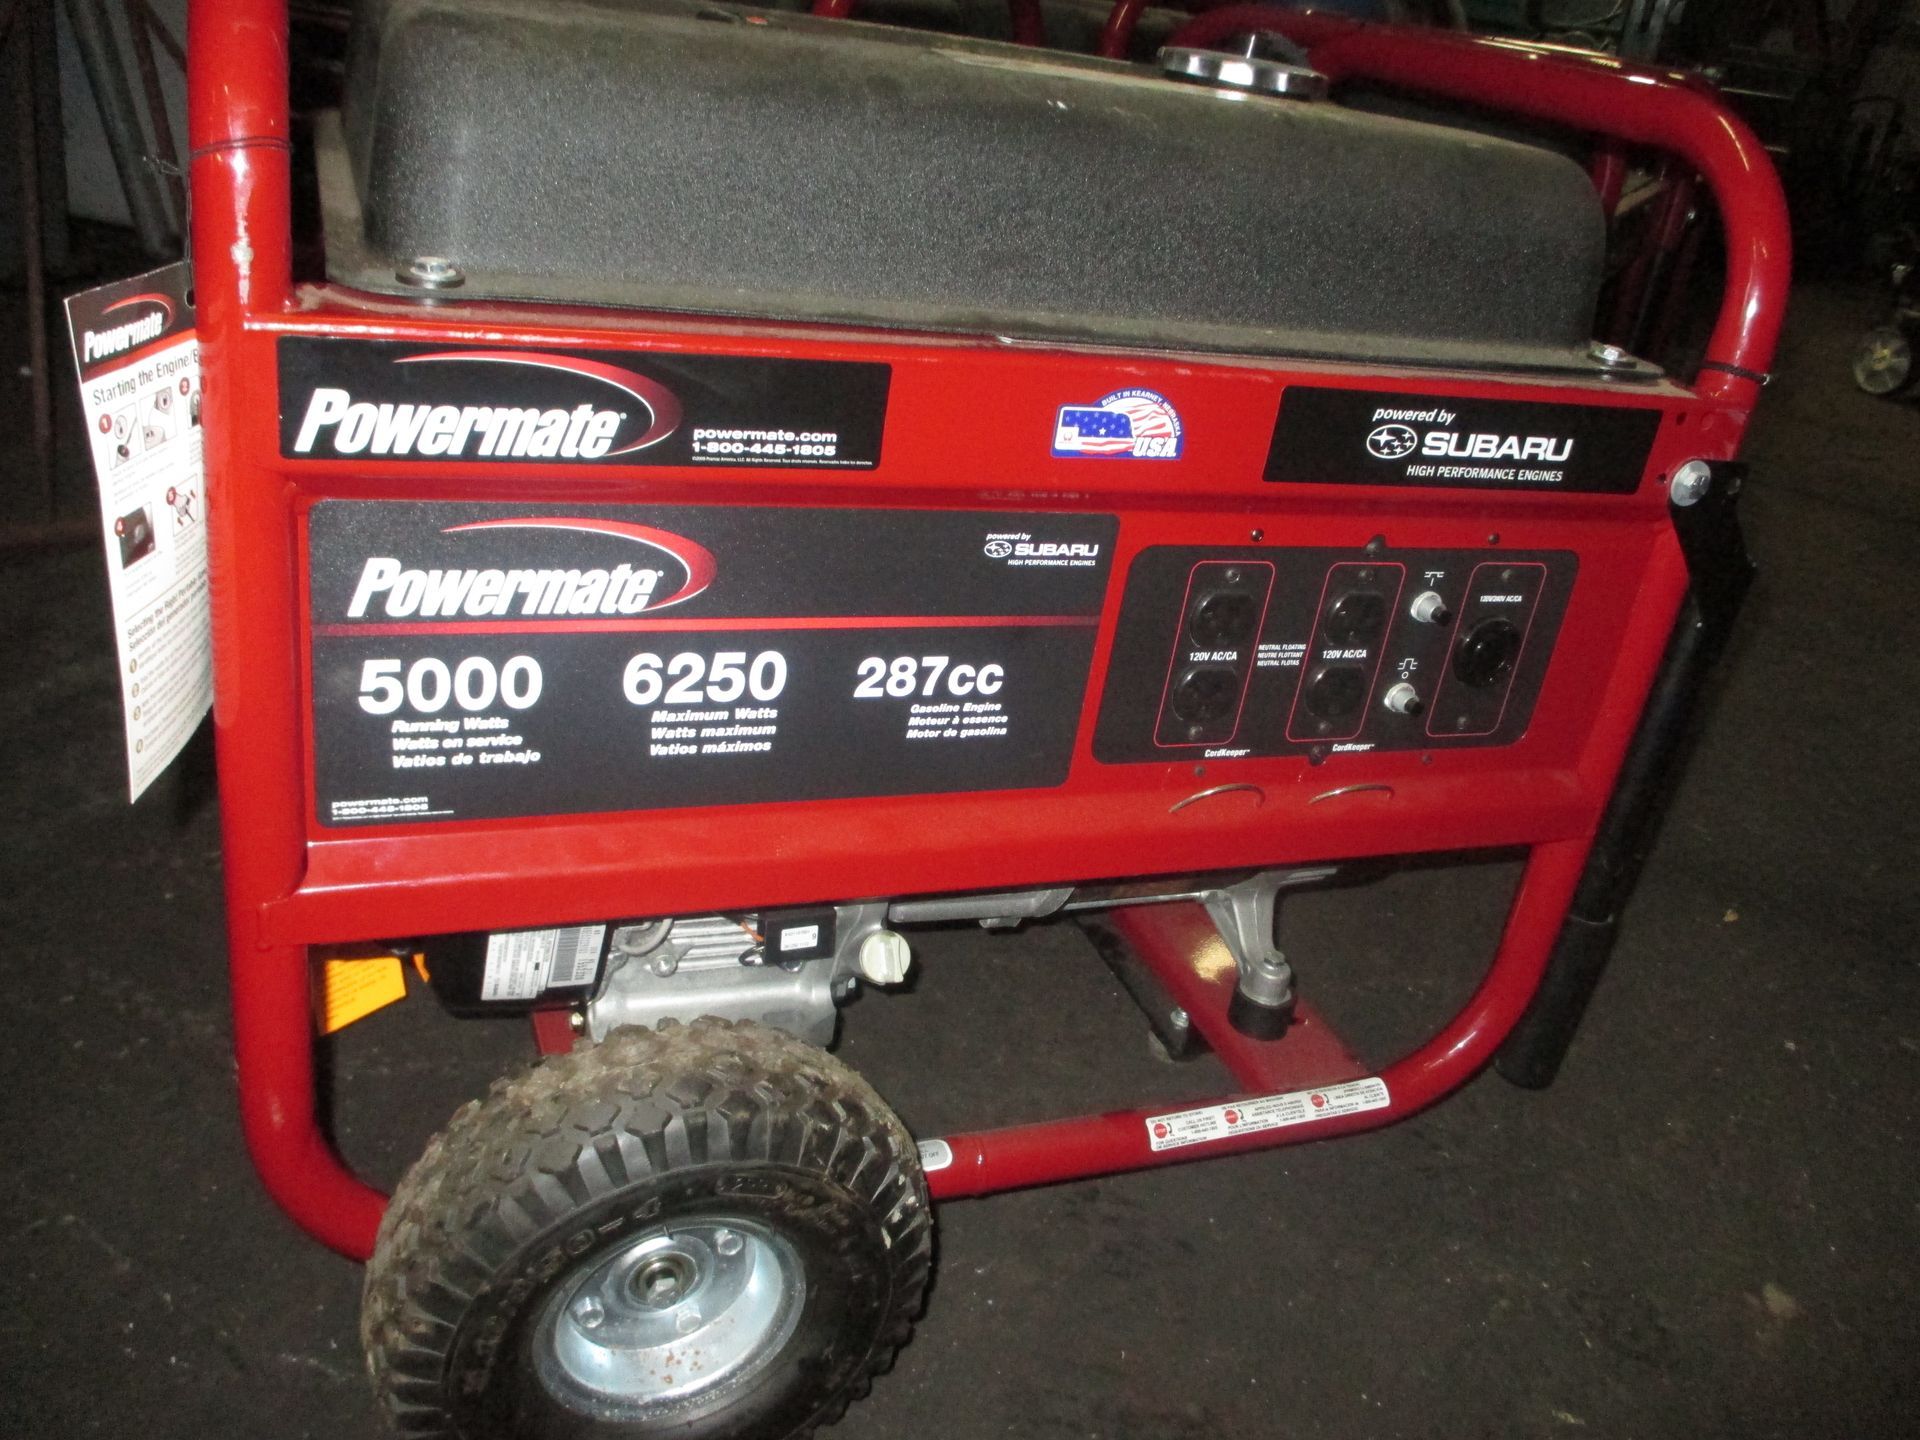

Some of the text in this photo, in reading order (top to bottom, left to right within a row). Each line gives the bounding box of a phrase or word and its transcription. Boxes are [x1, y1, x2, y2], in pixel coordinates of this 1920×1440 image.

[84, 312, 163, 363] Powermate
[93, 348, 200, 406] Starting the Engine/E
[1101, 391, 1121, 406] BUILT
[1122, 390, 1131, 398] IN
[294, 388, 620, 458] Powermate
[1372, 408, 1456, 425] powered by
[693, 429, 838, 443] powermate.com
[692, 442, 836, 456] 1-800-445-1805
[1422, 431, 1574, 462] SUBARU
[1406, 464, 1563, 482] HIGH PERFORMANCE ENGINES
[986, 532, 1031, 542] powered by
[1014, 543, 1099, 557] SUBARU
[1024, 559, 1069, 567] PERFORMANCE
[1070, 559, 1096, 567] ENGINES
[347, 557, 659, 618] Powermate
[1282, 643, 1306, 651] FLOATING
[1322, 649, 1367, 659] 120V AC/CA
[1189, 651, 1237, 661] 120V AC/CA
[358, 655, 543, 714] 5000
[623, 650, 787, 705] 6250
[853, 656, 1004, 697] 287cc
[651, 707, 778, 723] Maximum Watts
[910, 702, 1002, 714] Gasoline Engine
[391, 717, 509, 733] Running Watts
[908, 715, 950, 726] Moteur
[962, 715, 1008, 724] essence
[651, 724, 776, 739] Watts maximum
[906, 727, 1007, 738] Motor de gasolina
[392, 734, 523, 751] Watts en service
[650, 741, 772, 756] Vatios máximos
[392, 749, 541, 768] Vatios de trabajo
[332, 797, 428, 808] powermate.com
